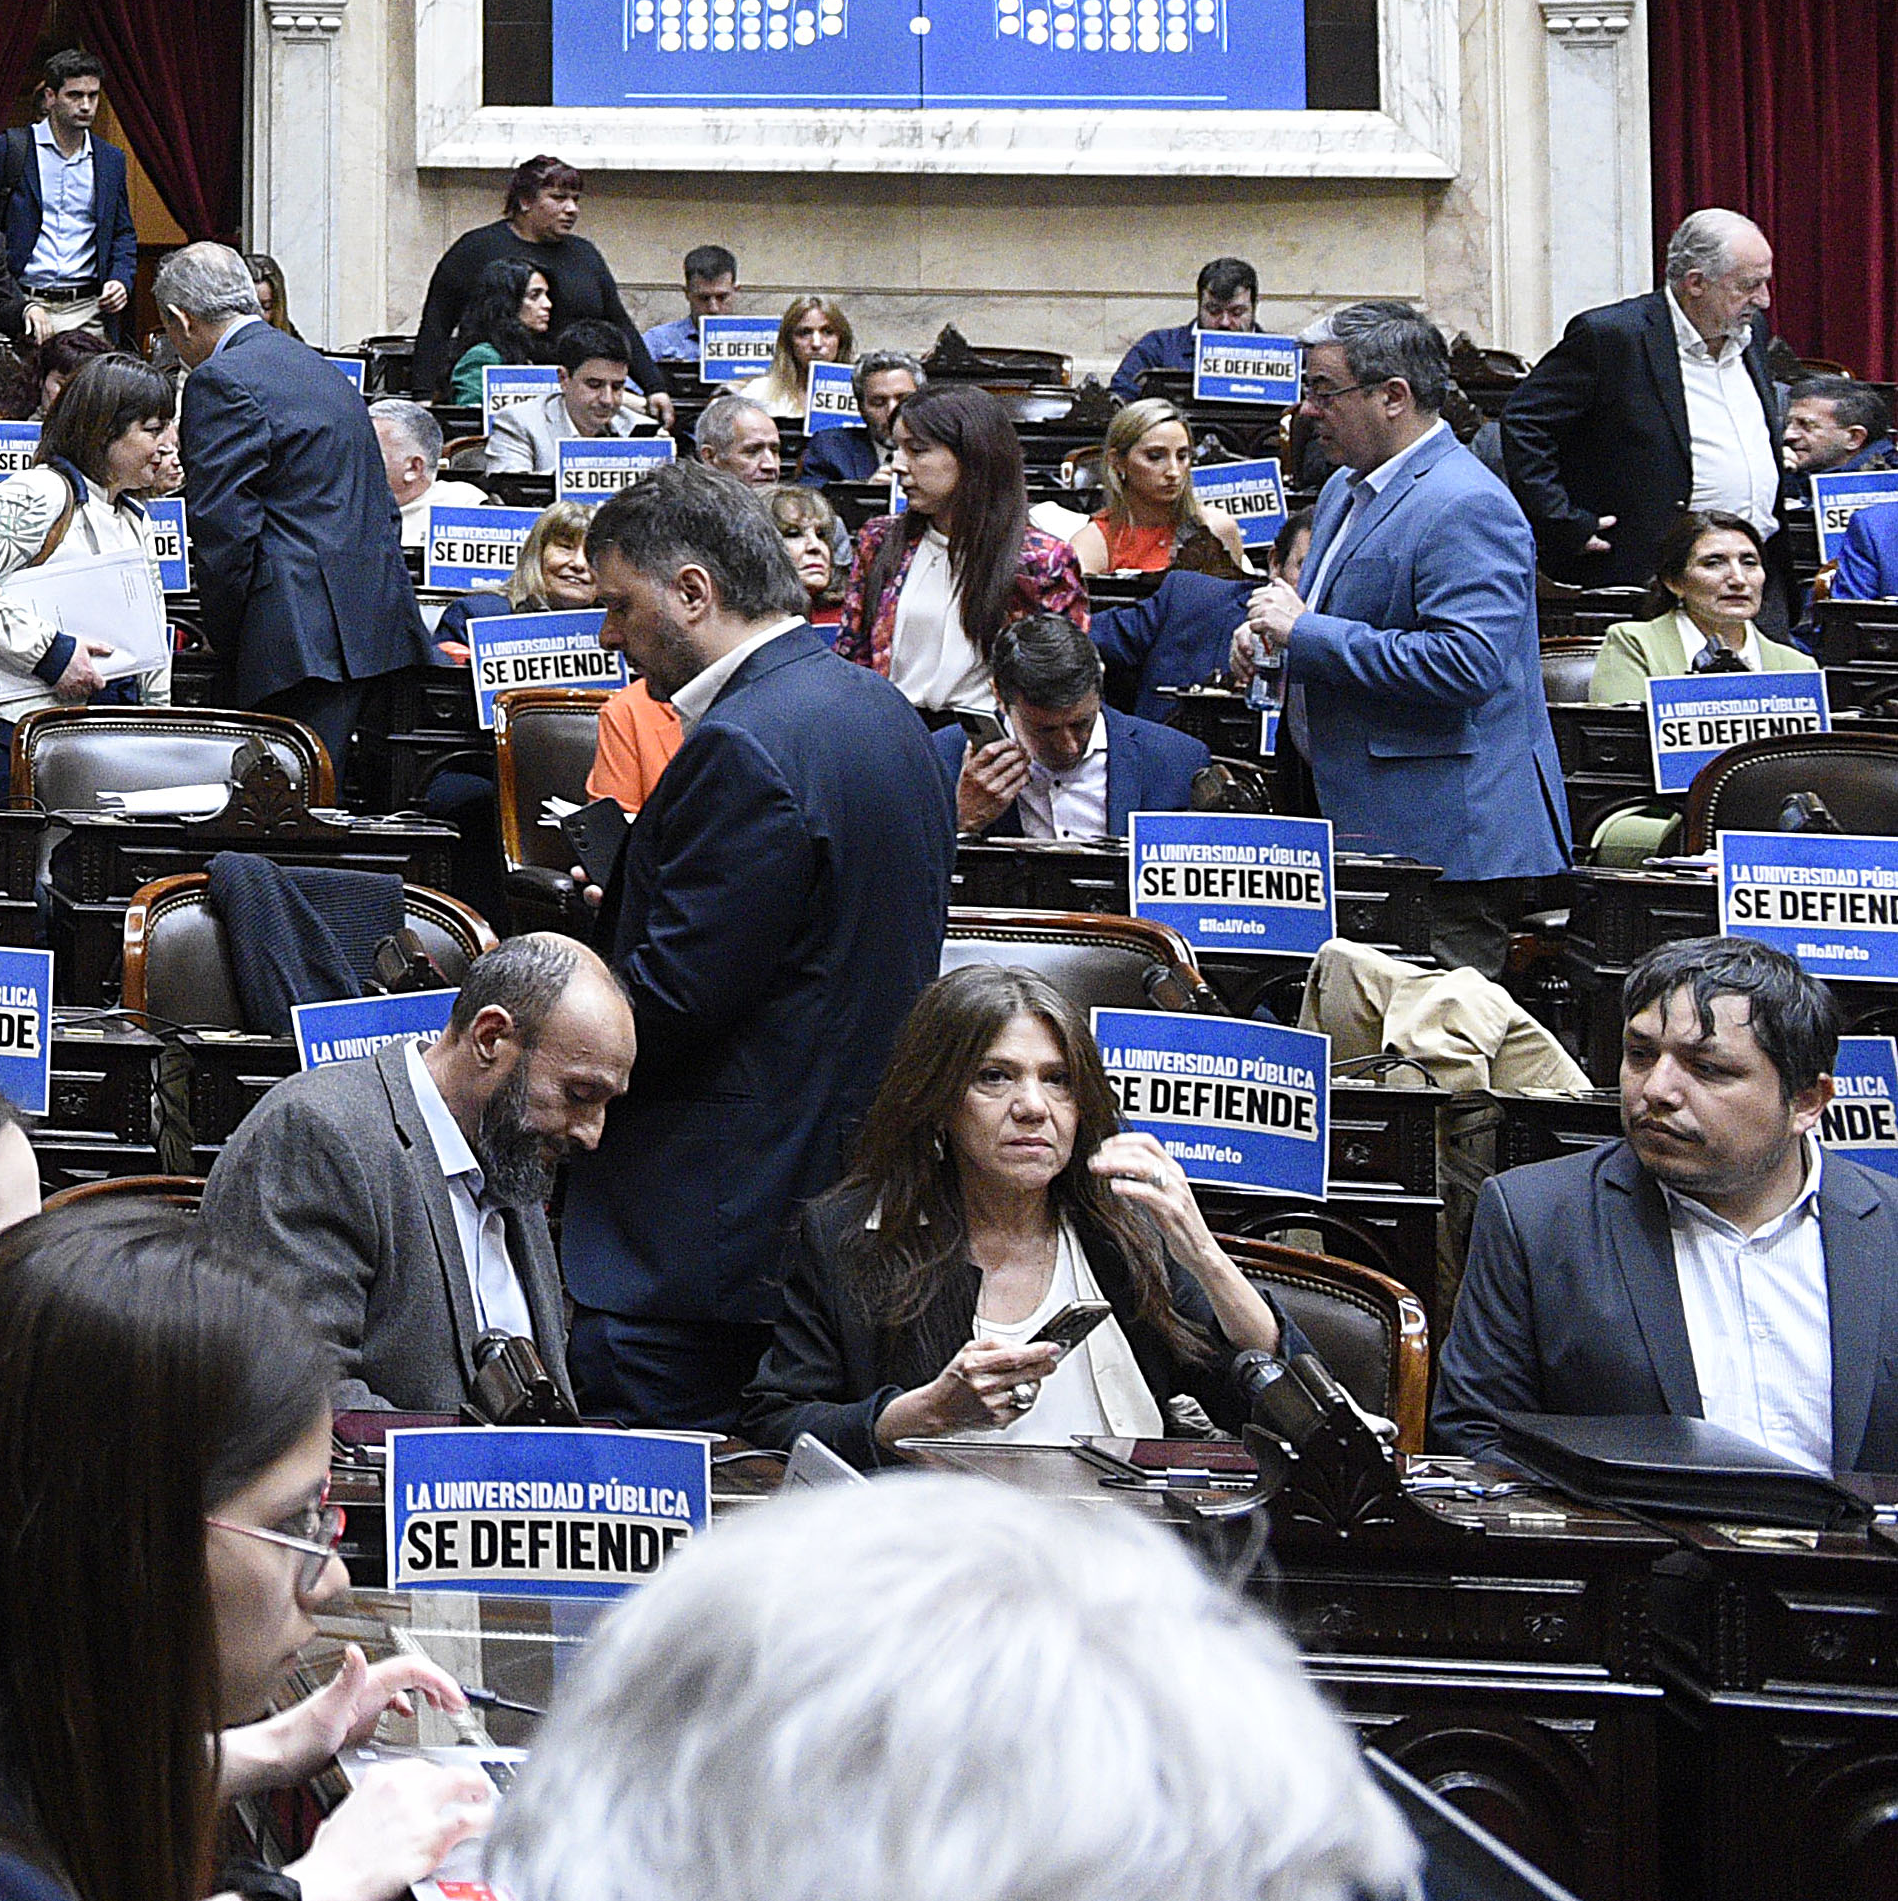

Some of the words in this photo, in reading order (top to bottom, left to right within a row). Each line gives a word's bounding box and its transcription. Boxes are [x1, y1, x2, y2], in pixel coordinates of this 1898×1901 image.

[707, 343, 724, 357] SE
[727, 343, 775, 357] DEFIEN
[1203, 358, 1221, 373] SE
[1224, 359, 1294, 378] DEFIENDE
[815, 392, 834, 409] SE
[0, 453, 18, 471] SE
[564, 471, 585, 488] SE
[1826, 509, 1849, 528] SE
[435, 541, 458, 561] SE
[463, 543, 522, 565] DEFIE
[479, 644, 493, 658] LA
[493, 638, 565, 656] UNIVERSIDAD
[484, 660, 509, 684] SE
[513, 652, 618, 682] DEFIENDE
[1658, 704, 1674, 719] LA
[1675, 698, 1759, 718] UNIVERSIDAD
[1761, 694, 1817, 714] PÚBLICA
[1664, 722, 1692, 747] SE
[1698, 717, 1817, 745] DEFIENDE
[1142, 844, 1161, 860] LA
[1162, 843, 1256, 864] UNIVERSIDAD
[1259, 844, 1322, 868] PÚBLICA
[1143, 866, 1179, 896] SE
[1184, 869, 1322, 903] DEFIENDE
[1732, 864, 1753, 882] LA
[1753, 865, 1859, 887] UNIVERSIDAD
[1734, 889, 1771, 920] SE
[311, 1041, 333, 1063] LA
[1104, 1047, 1124, 1067] LA
[1125, 1048, 1239, 1079] UNIVERSIDAD
[1242, 1056, 1316, 1091] PÚBLICA
[1833, 1076, 1890, 1097] BLICA
[1150, 1078, 1314, 1134] DEFIENDE
[406, 1483, 432, 1511] LA
[435, 1481, 584, 1510] UNIVERSIDAD
[589, 1477, 691, 1518] PÚBLICA
[407, 1520, 458, 1571] SE
